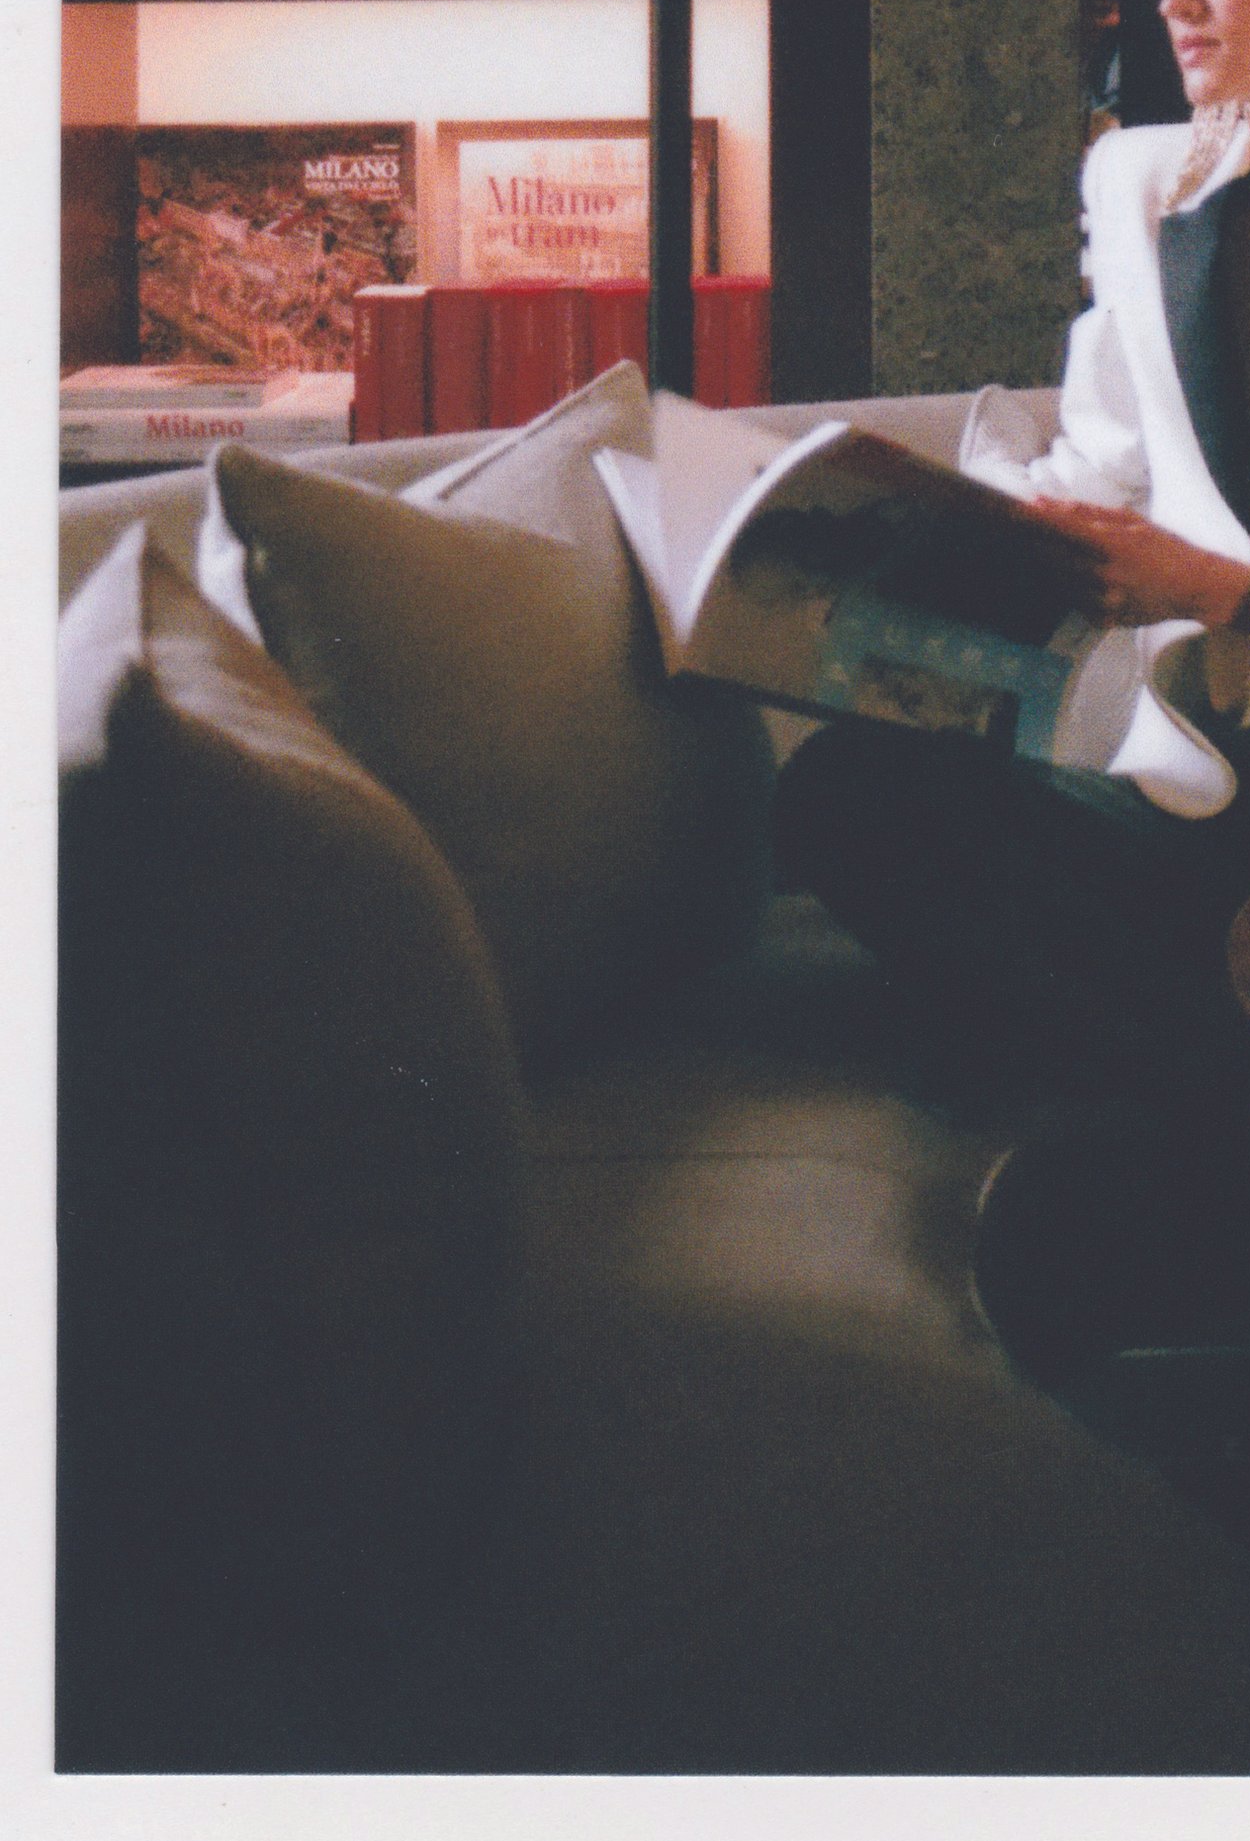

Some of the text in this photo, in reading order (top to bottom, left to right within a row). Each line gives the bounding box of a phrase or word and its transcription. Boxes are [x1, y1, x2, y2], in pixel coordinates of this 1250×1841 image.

[303, 158, 400, 179] MILANO
[486, 175, 617, 215] Milano
[511, 222, 600, 248] tram
[145, 414, 246, 440] Milano
